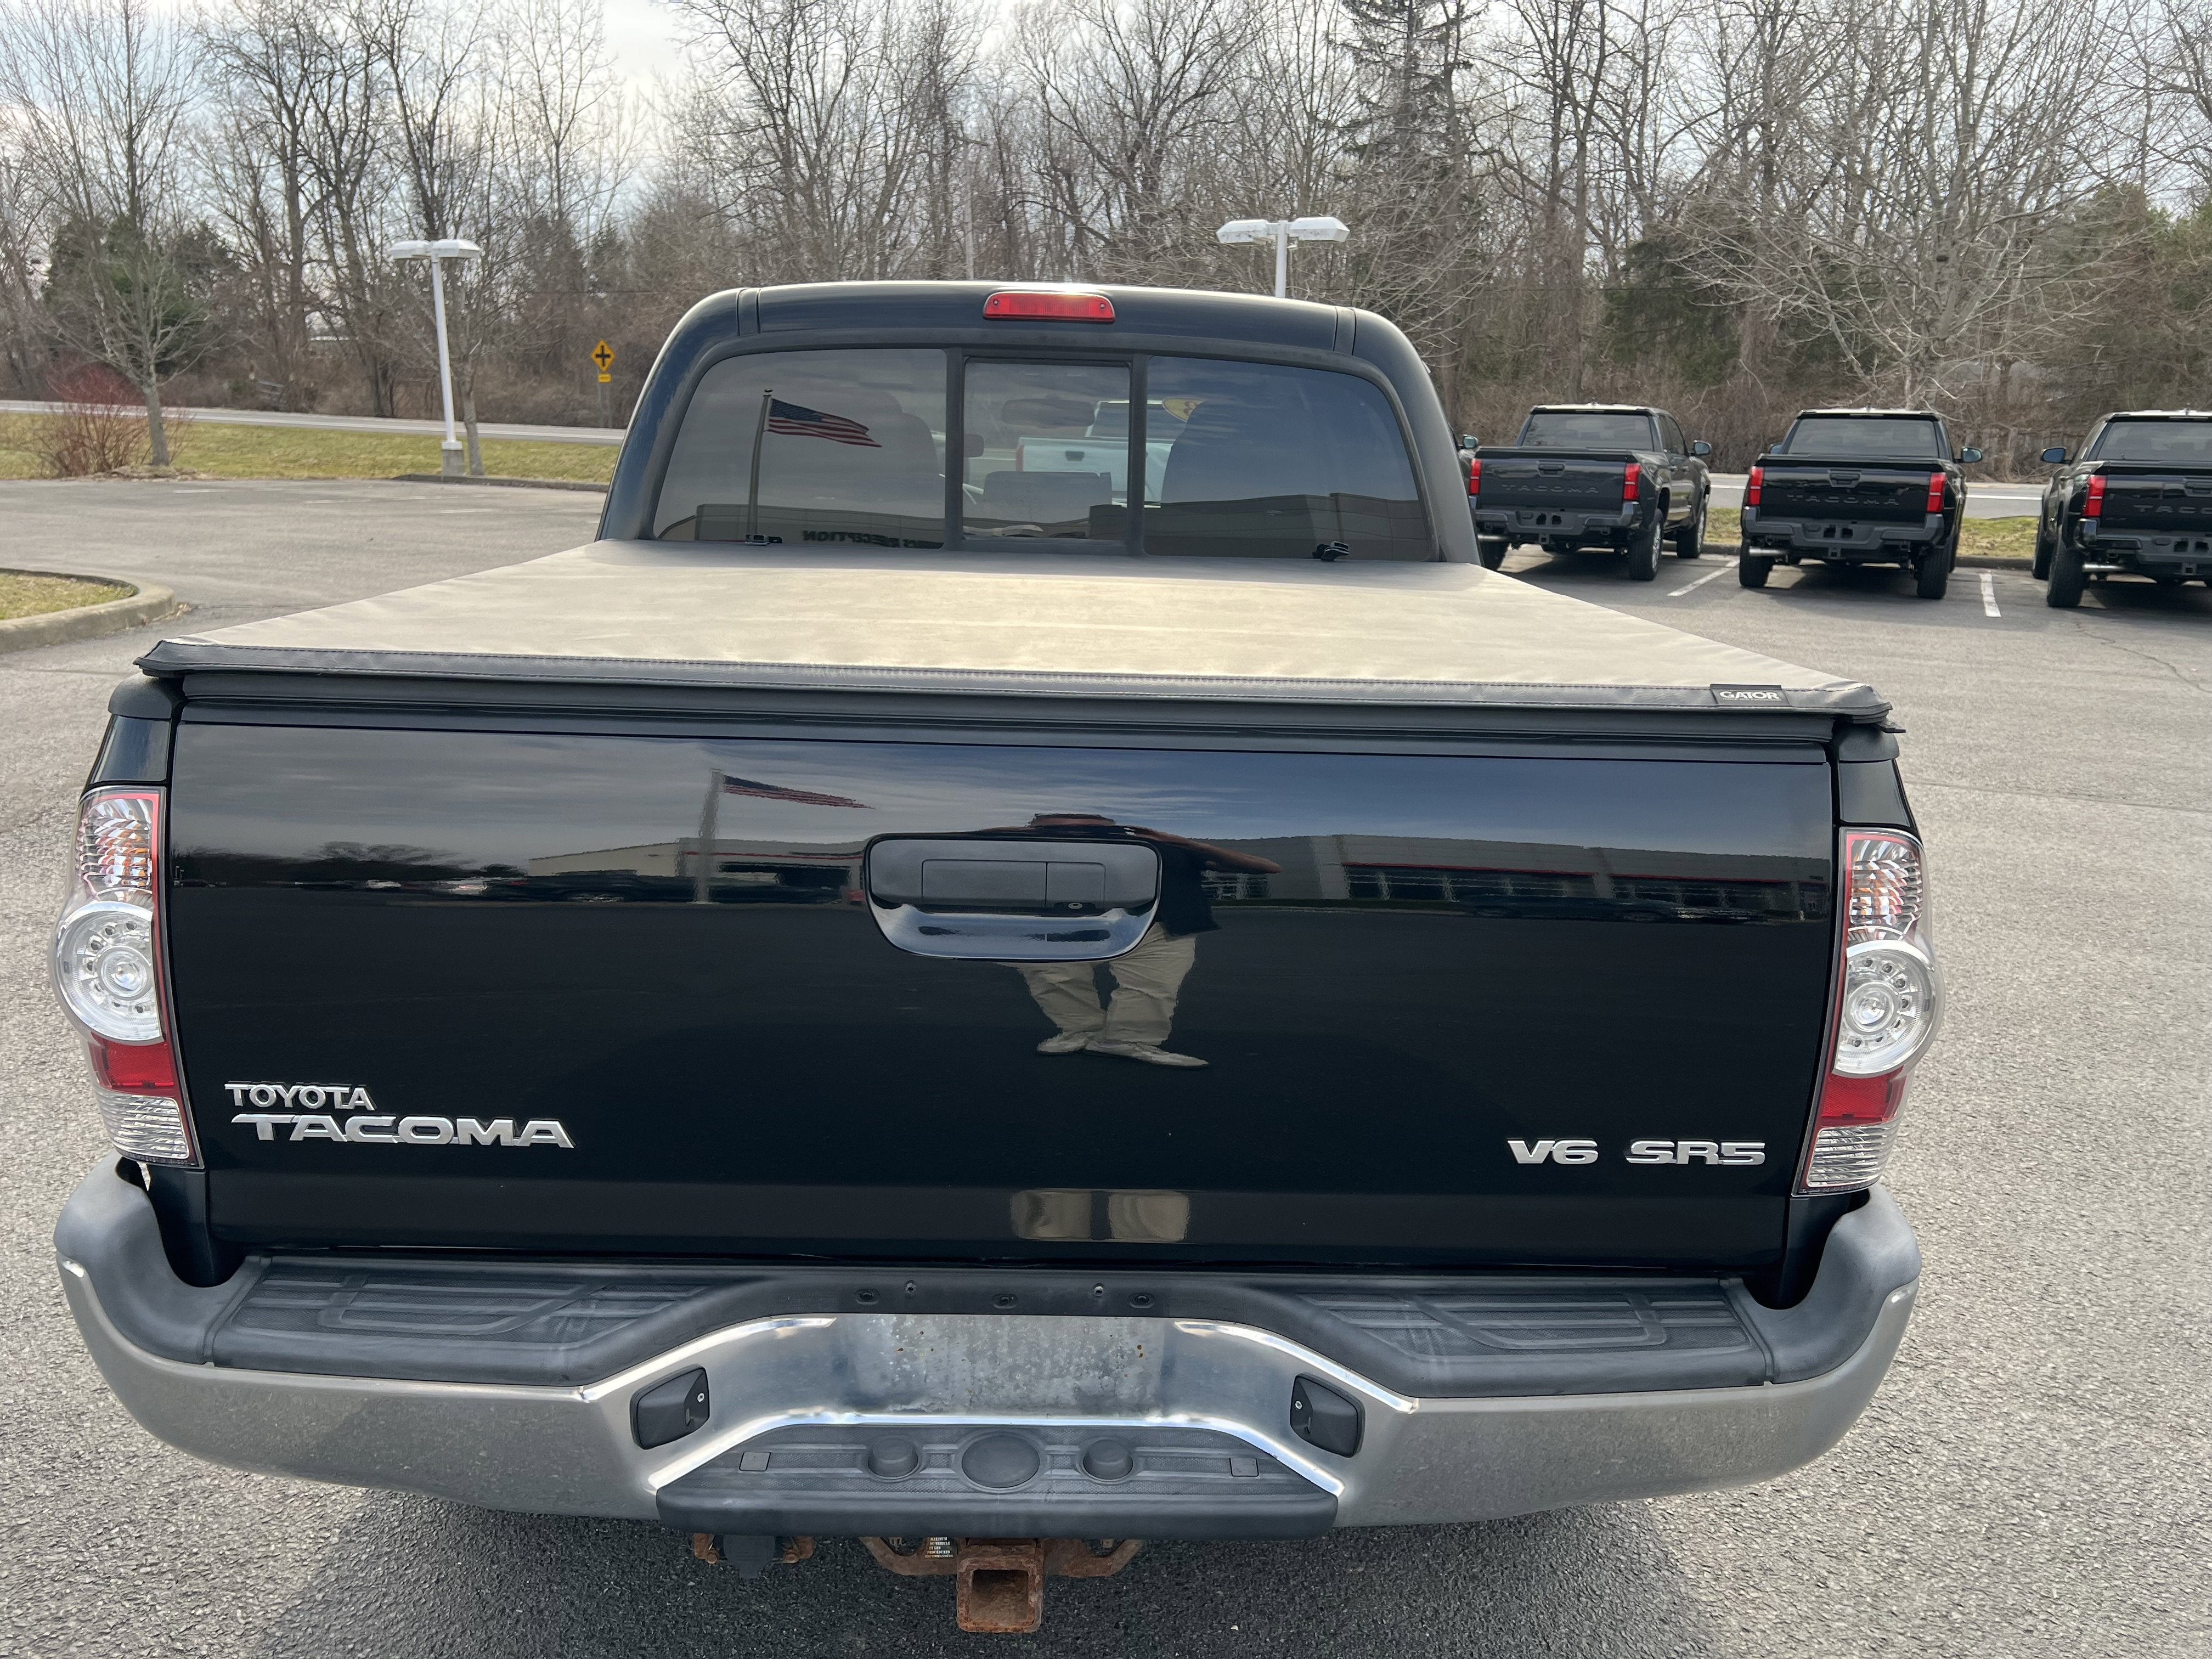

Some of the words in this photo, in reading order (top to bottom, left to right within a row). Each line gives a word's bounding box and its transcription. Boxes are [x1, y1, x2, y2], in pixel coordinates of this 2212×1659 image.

[1502, 484, 1599, 494] TACOMA
[1787, 494, 1899, 505] TACOMA
[1719, 691, 1780, 699] GATOR
[224, 1082, 377, 1111] TOYOTA
[231, 1113, 575, 1149] TACOMA
[1507, 1139, 1599, 1165] V6
[1625, 1140, 1765, 1166] SR5
